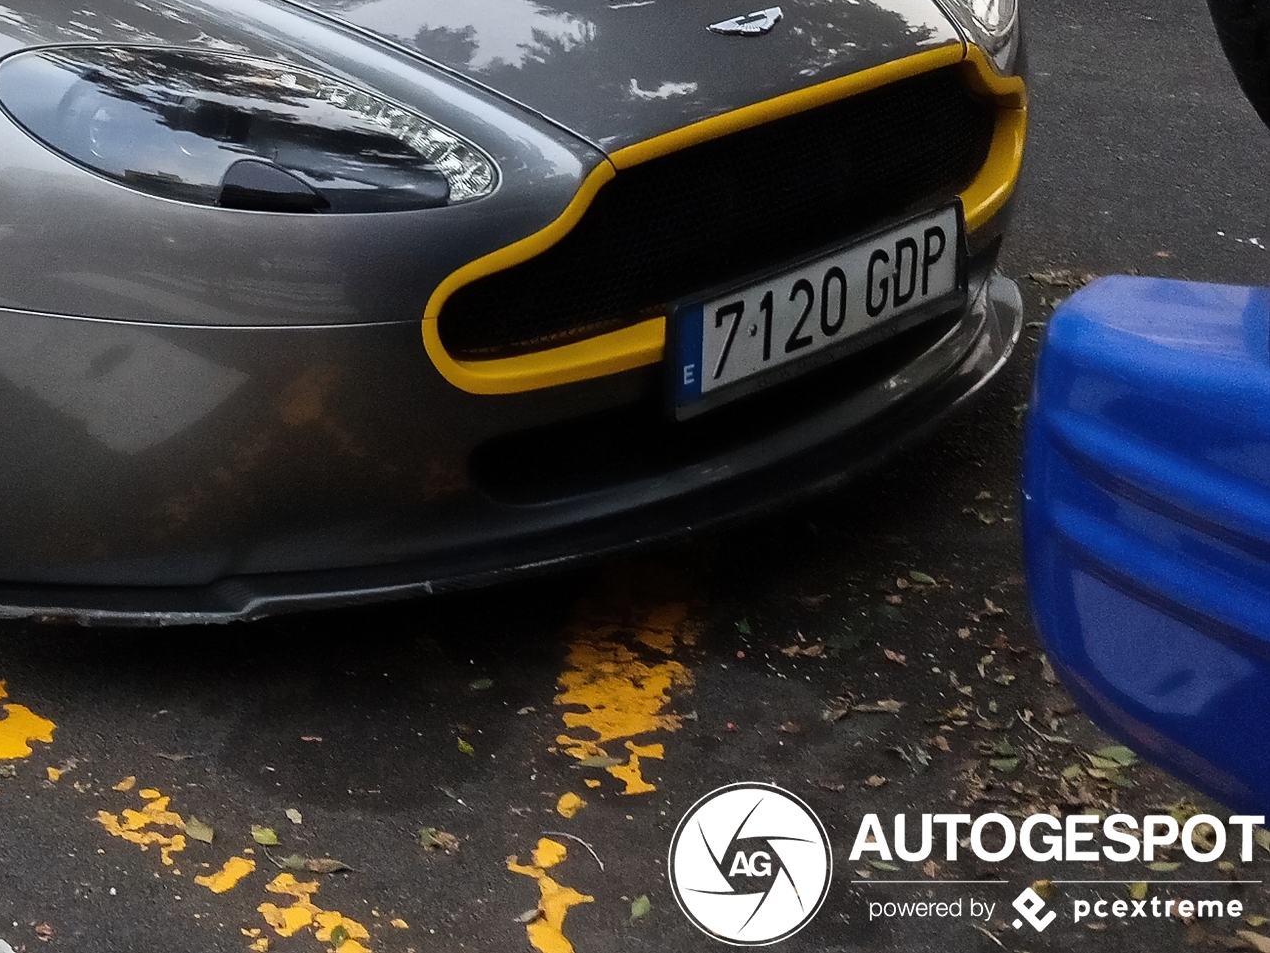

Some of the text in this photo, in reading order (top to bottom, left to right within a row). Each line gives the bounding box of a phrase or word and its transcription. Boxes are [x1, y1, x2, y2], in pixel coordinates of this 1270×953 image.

[714, 225, 946, 380] 7120 GDP
[683, 364, 695, 385] E
